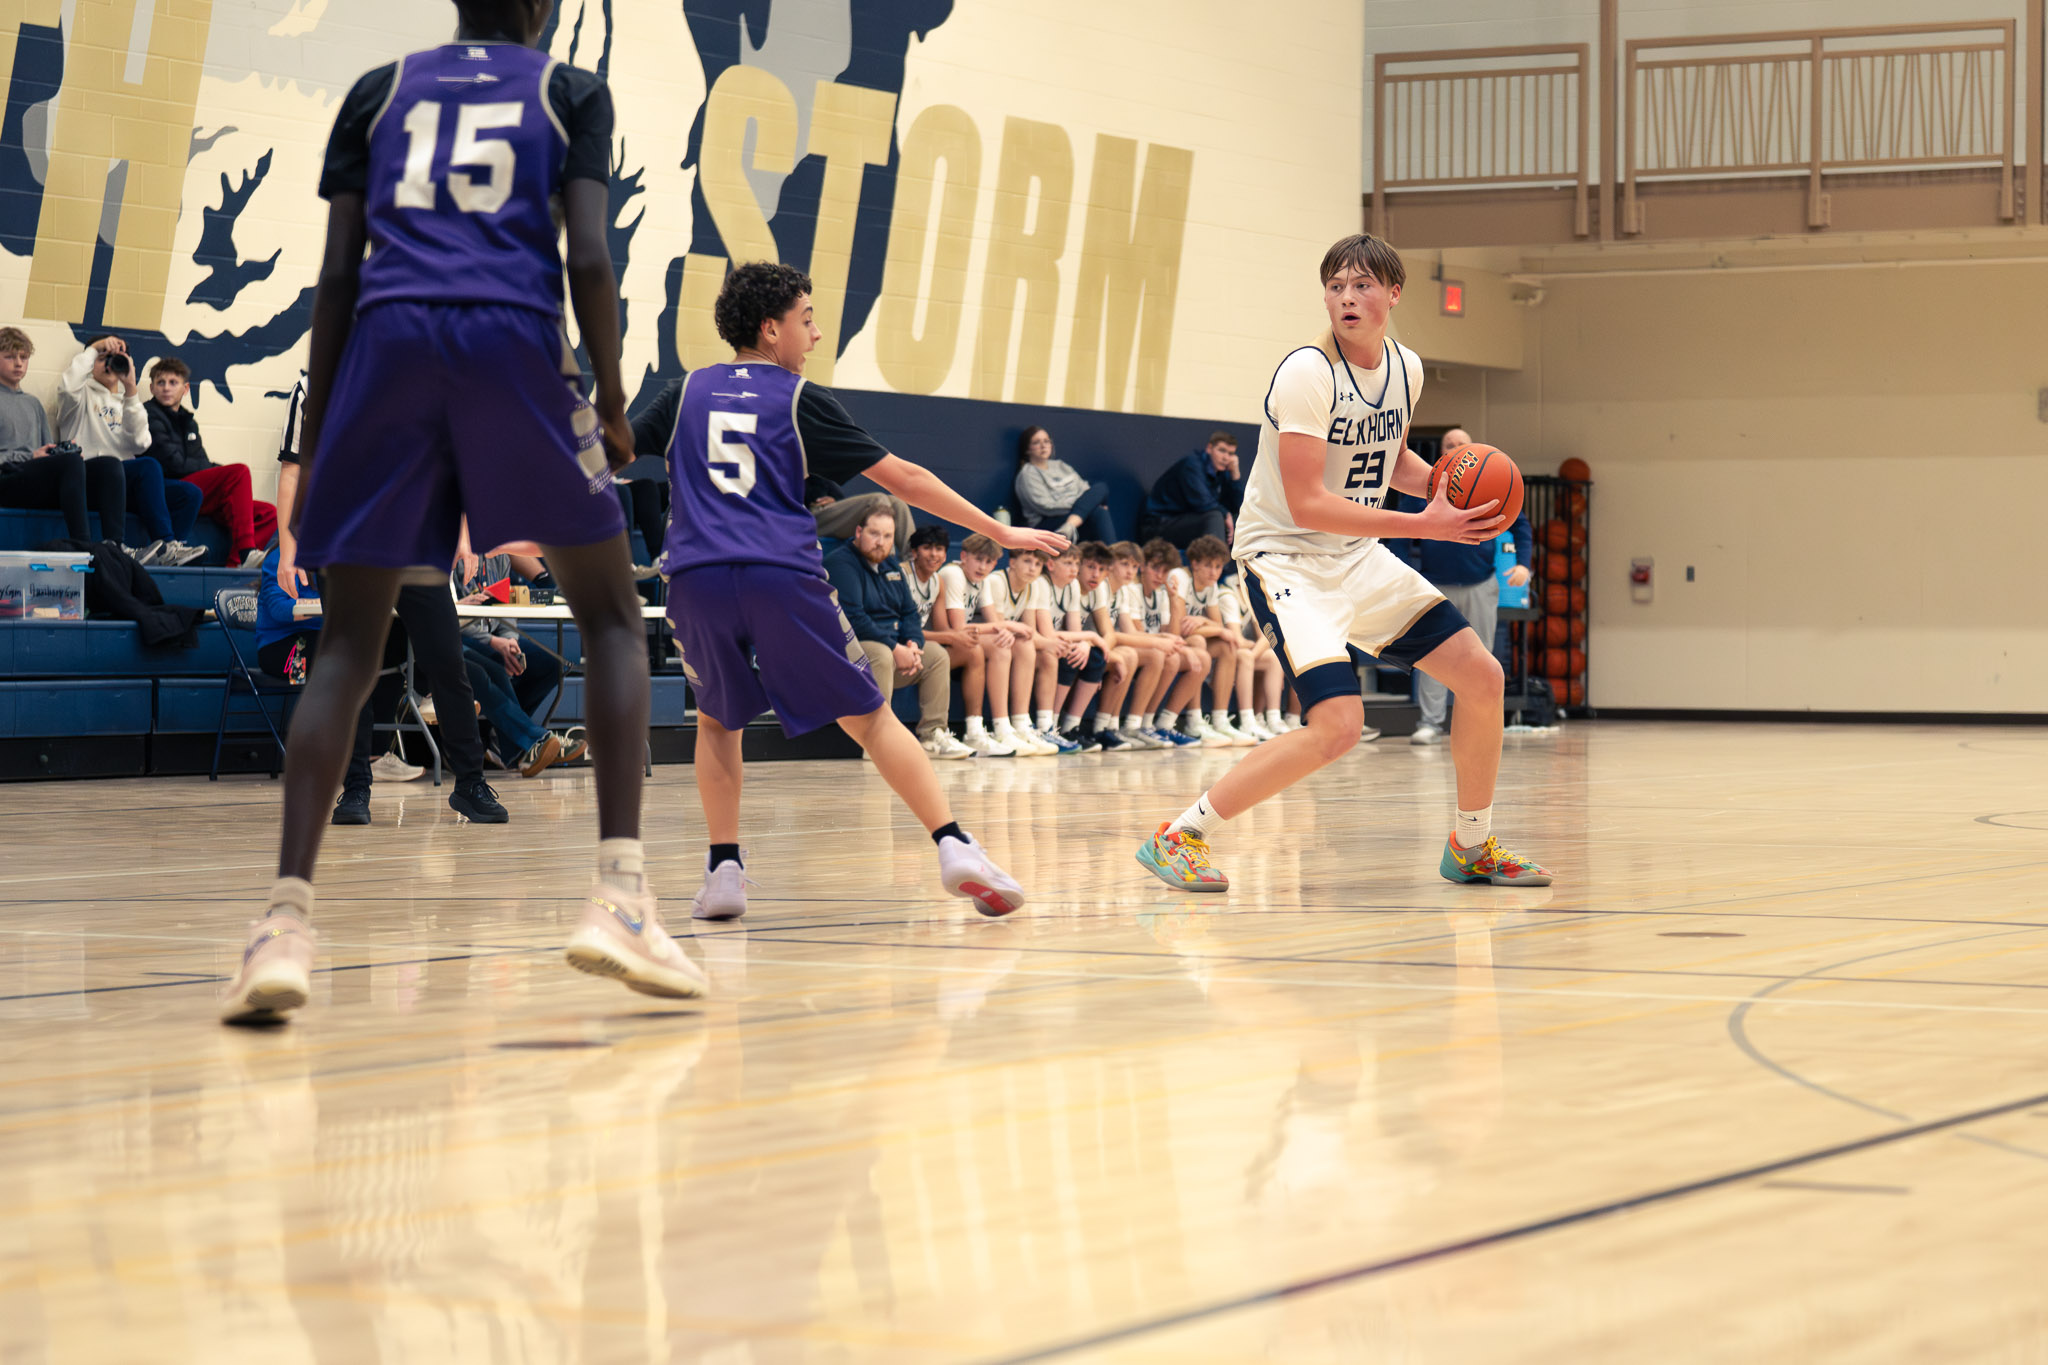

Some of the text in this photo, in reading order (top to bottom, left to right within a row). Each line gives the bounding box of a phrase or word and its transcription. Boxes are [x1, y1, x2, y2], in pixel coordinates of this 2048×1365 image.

[394, 100, 525, 214] 15
[675, 64, 1195, 416] STORM
[707, 411, 759, 498] 5
[1327, 407, 1403, 446] ELKHORN
[1344, 450, 1386, 489] 23
